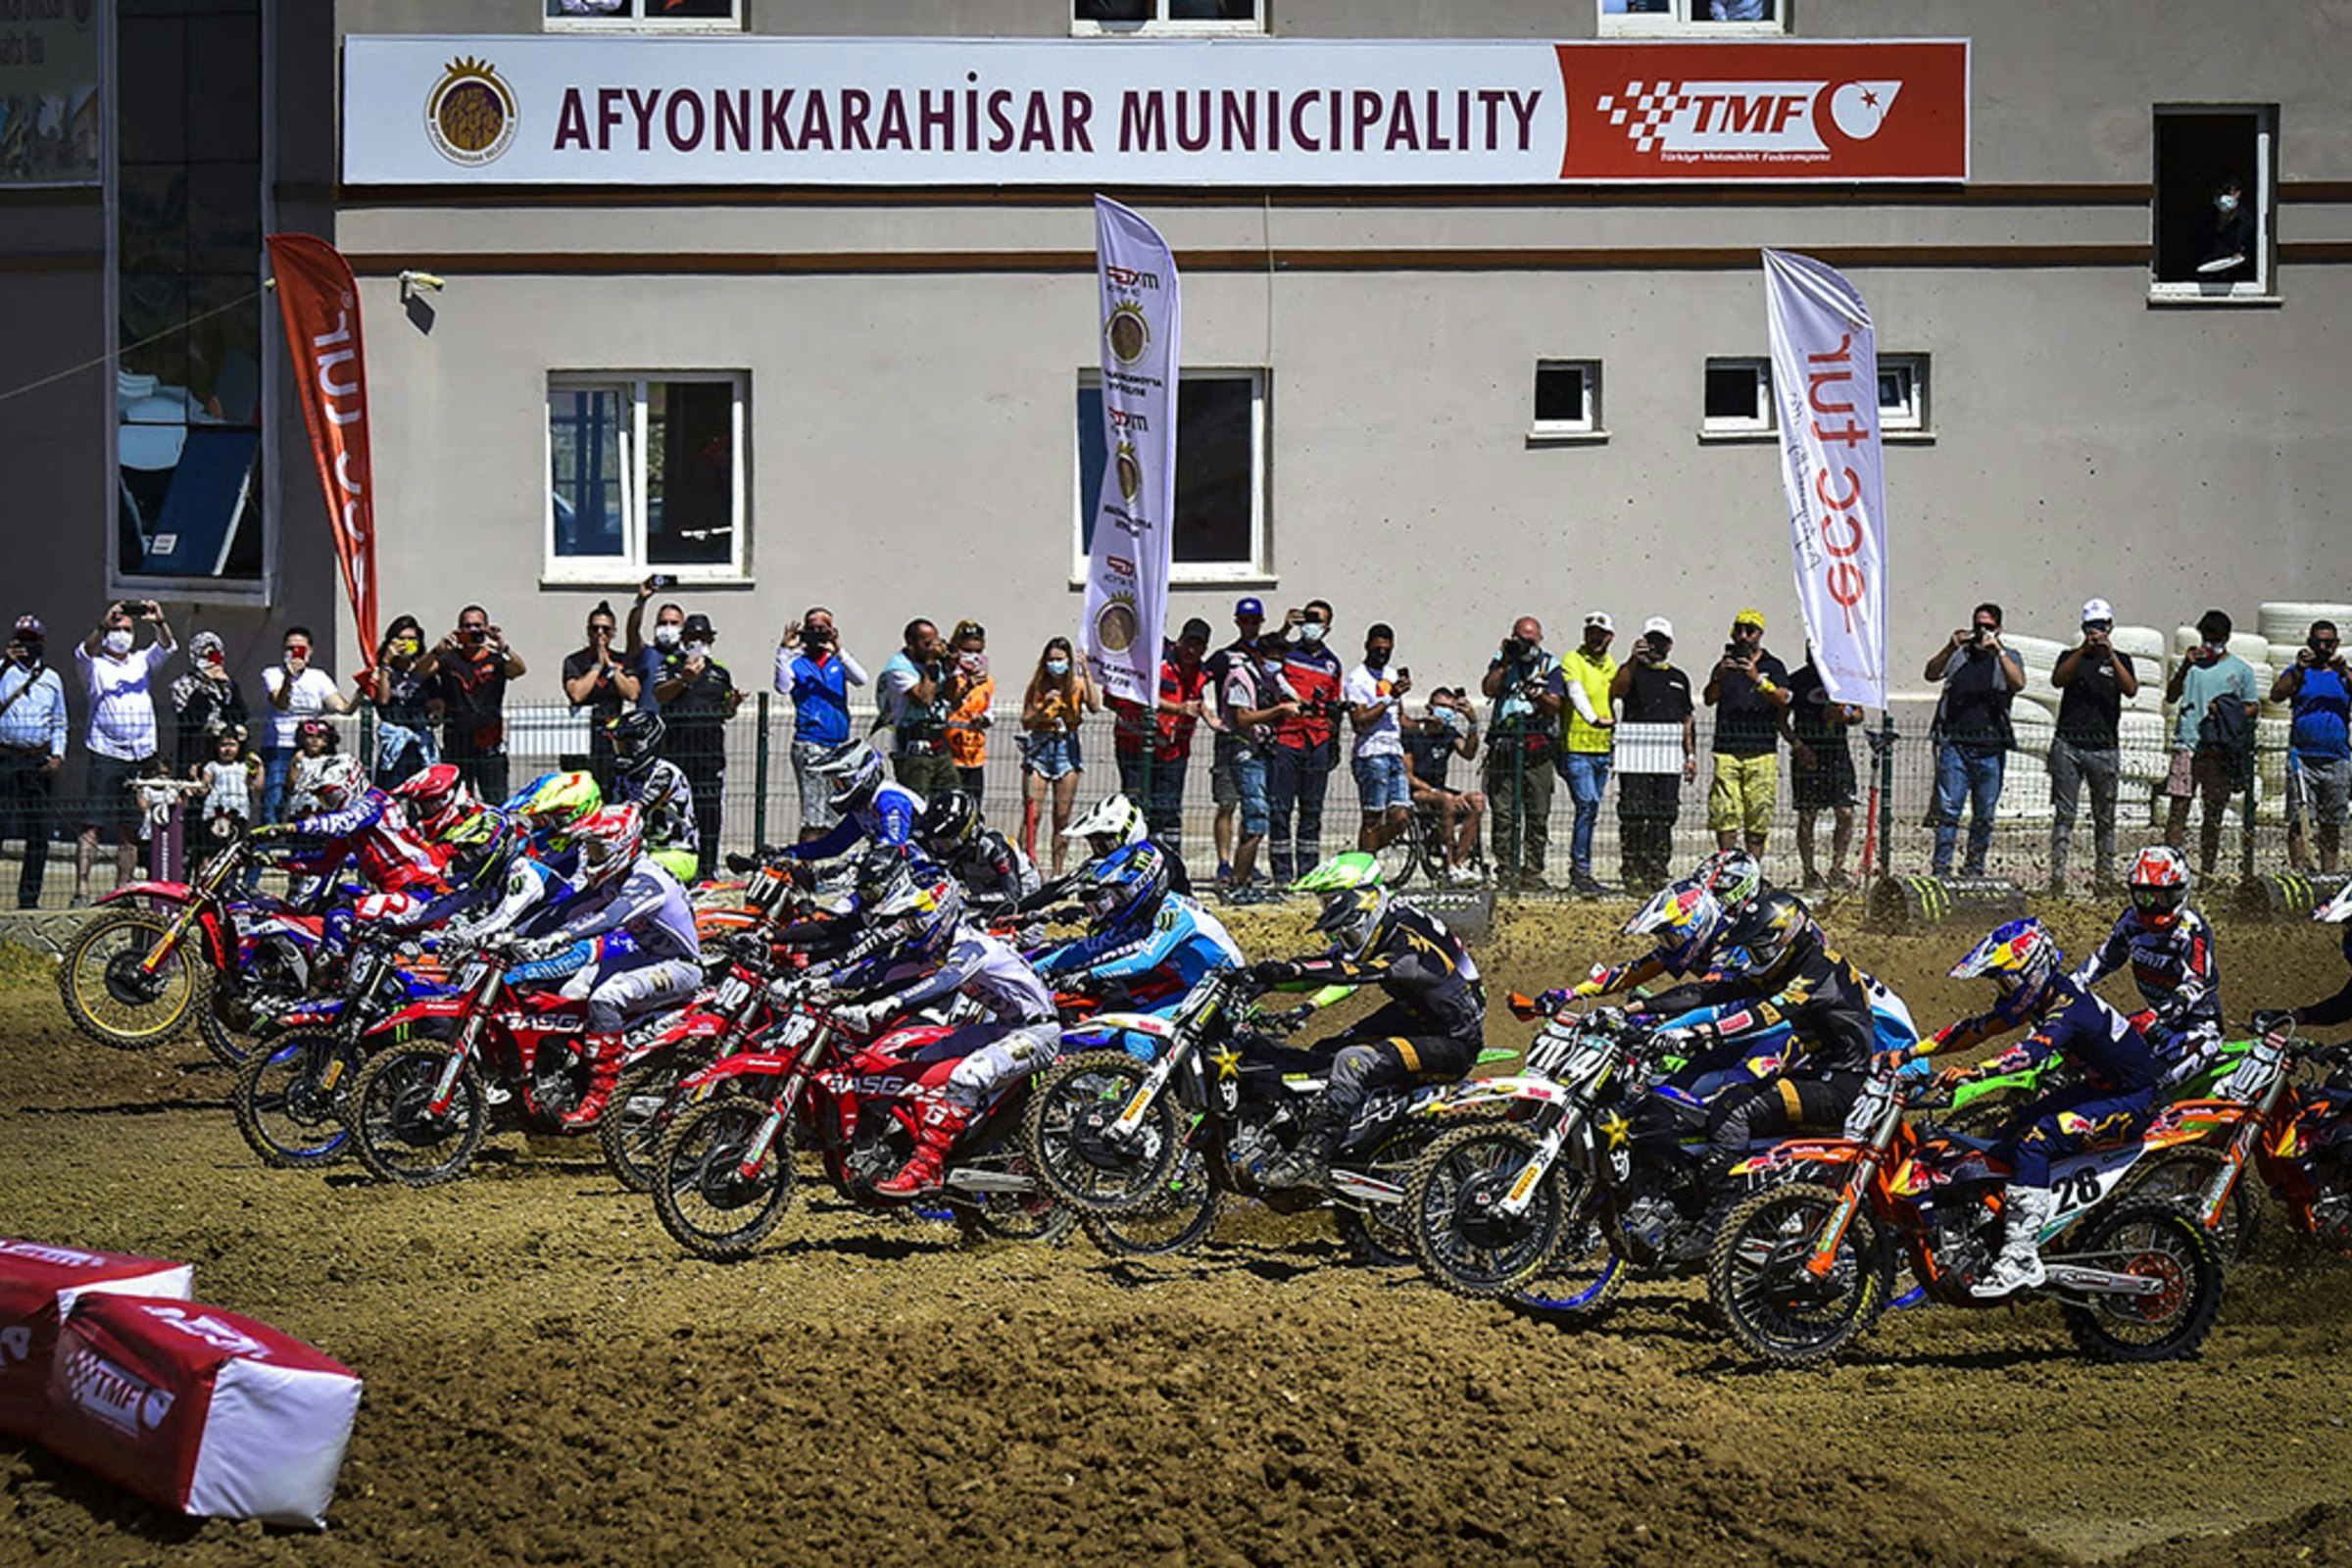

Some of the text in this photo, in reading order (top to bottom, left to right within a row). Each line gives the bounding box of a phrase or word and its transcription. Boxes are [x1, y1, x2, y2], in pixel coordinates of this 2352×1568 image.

[554, 72, 1542, 152] AFYONKARAHİSAR MUNICIPALITY
[1690, 94, 1809, 135] TMF
[1844, 1093, 1883, 1131] 28
[2051, 1165, 2101, 1215] 28
[94, 1366, 140, 1410] TMF
